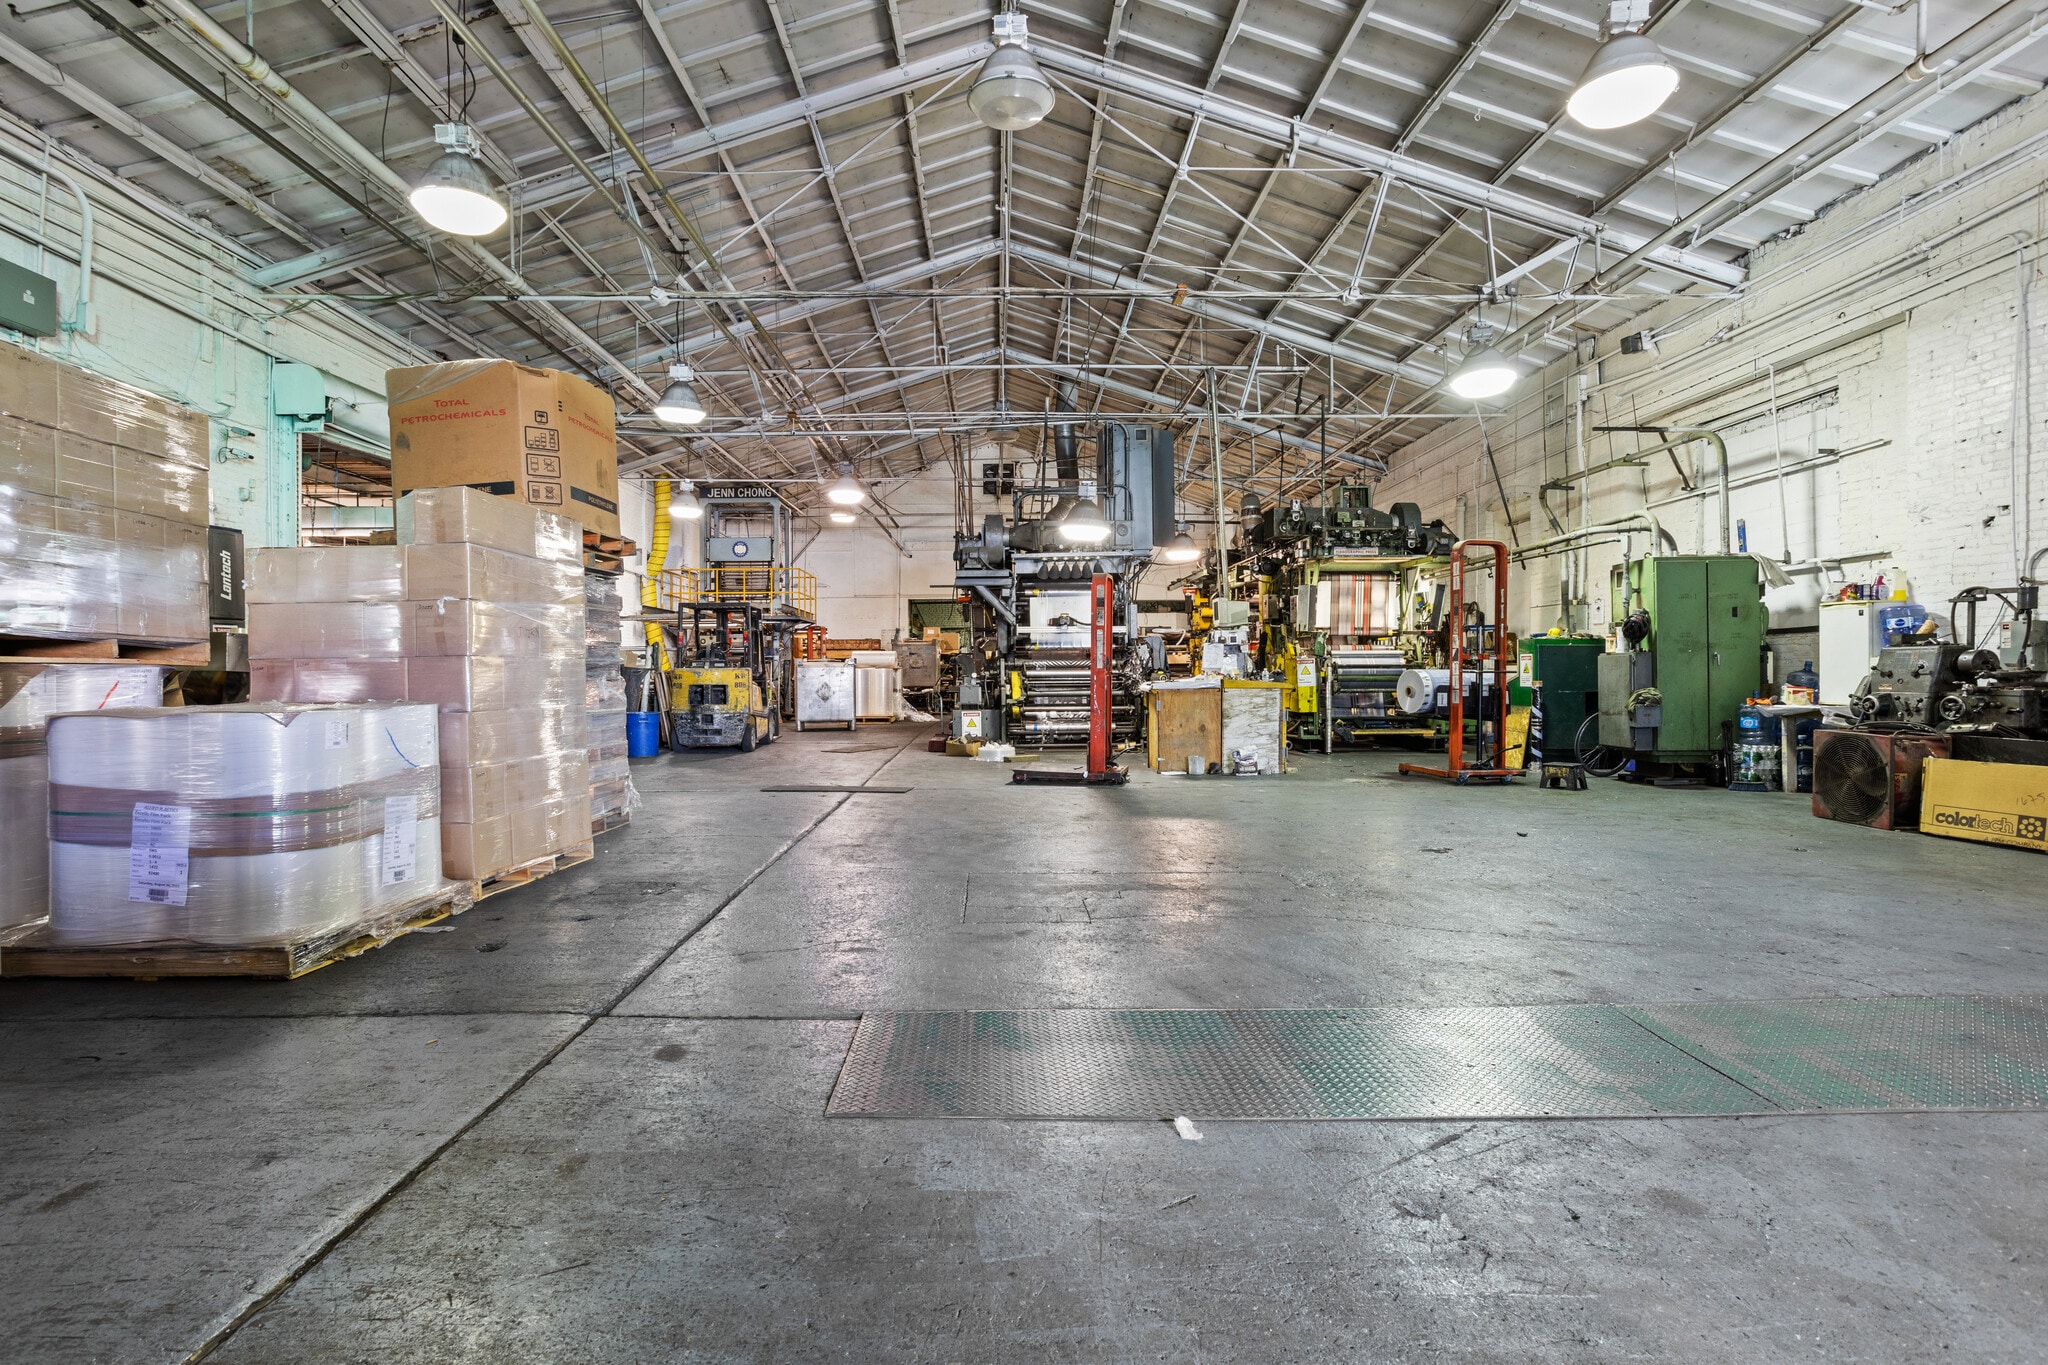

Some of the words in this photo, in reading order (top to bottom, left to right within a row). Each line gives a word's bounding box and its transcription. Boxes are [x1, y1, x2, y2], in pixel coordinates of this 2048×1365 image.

[433, 398, 471, 408] TOTAL
[401, 408, 507, 425] PETROCHEMICALS
[583, 412, 600, 426] TOTAL
[567, 415, 613, 444] PETROCHEMICALS
[707, 488, 735, 498] JENN
[737, 487, 772, 497] CHONG
[219, 550, 232, 601] Lantech
[1935, 811, 2015, 834] colortech
